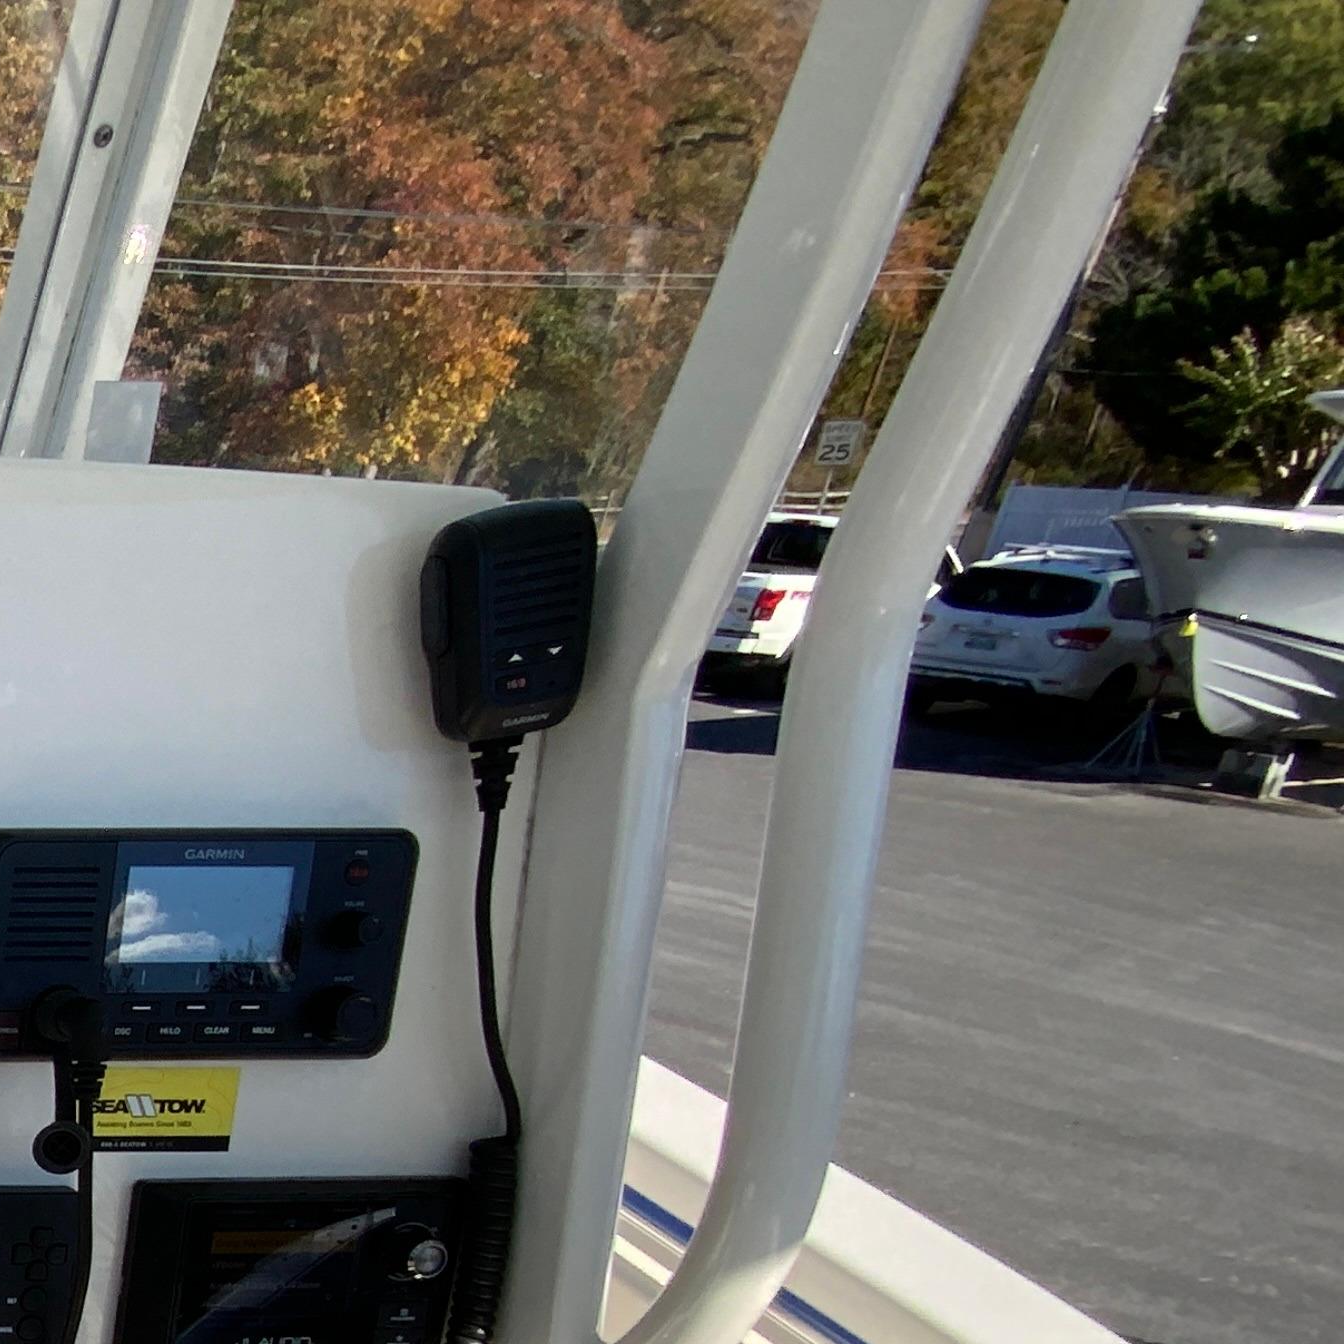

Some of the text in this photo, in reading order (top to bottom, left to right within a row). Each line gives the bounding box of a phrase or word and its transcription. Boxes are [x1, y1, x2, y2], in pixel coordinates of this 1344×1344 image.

[818, 443, 850, 461] 25
[184, 849, 246, 860] GARMIN
[204, 1027, 230, 1035] CLEAR
[91, 1099, 127, 1114] SEA
